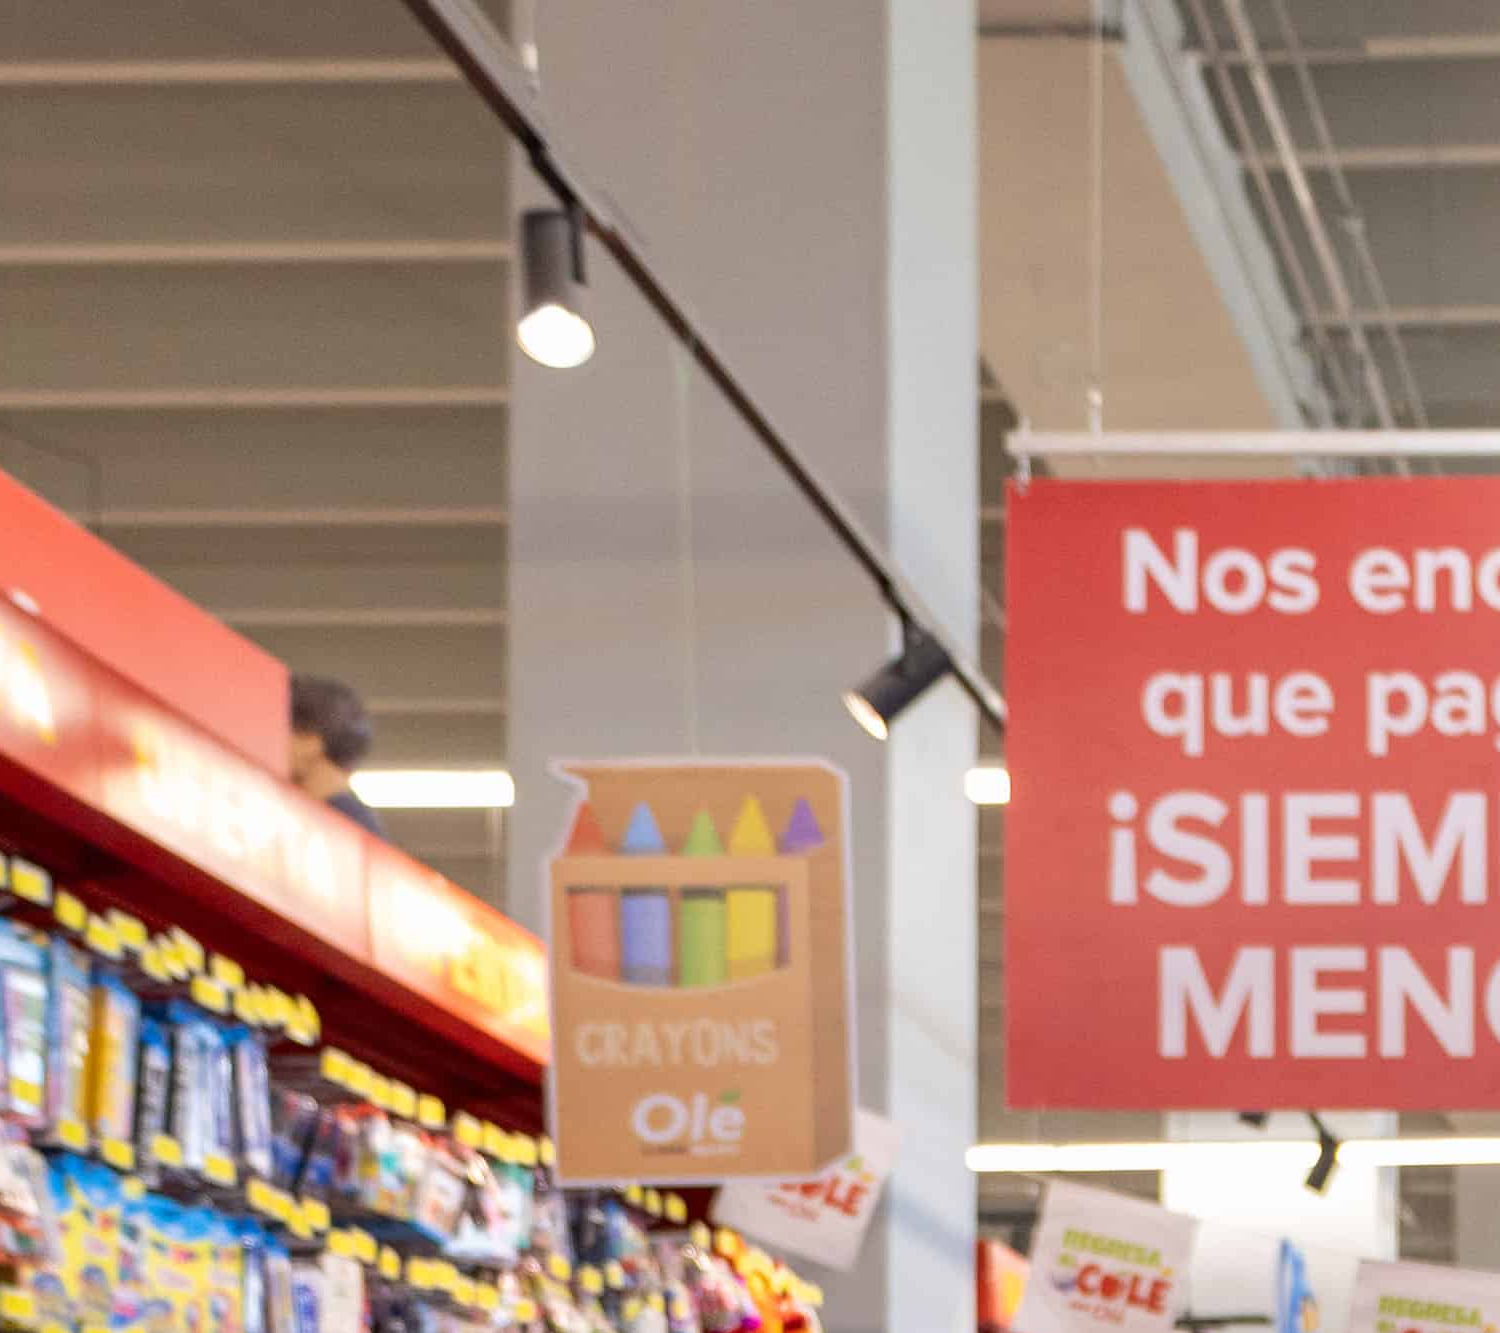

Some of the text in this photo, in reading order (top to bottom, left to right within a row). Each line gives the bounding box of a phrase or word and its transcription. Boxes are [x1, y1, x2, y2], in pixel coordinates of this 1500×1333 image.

[1123, 528, 1320, 615] Nos
[1141, 670, 1335, 758] que
[574, 1017, 780, 1067] CRAYONS
[631, 1089, 747, 1144] Olé
